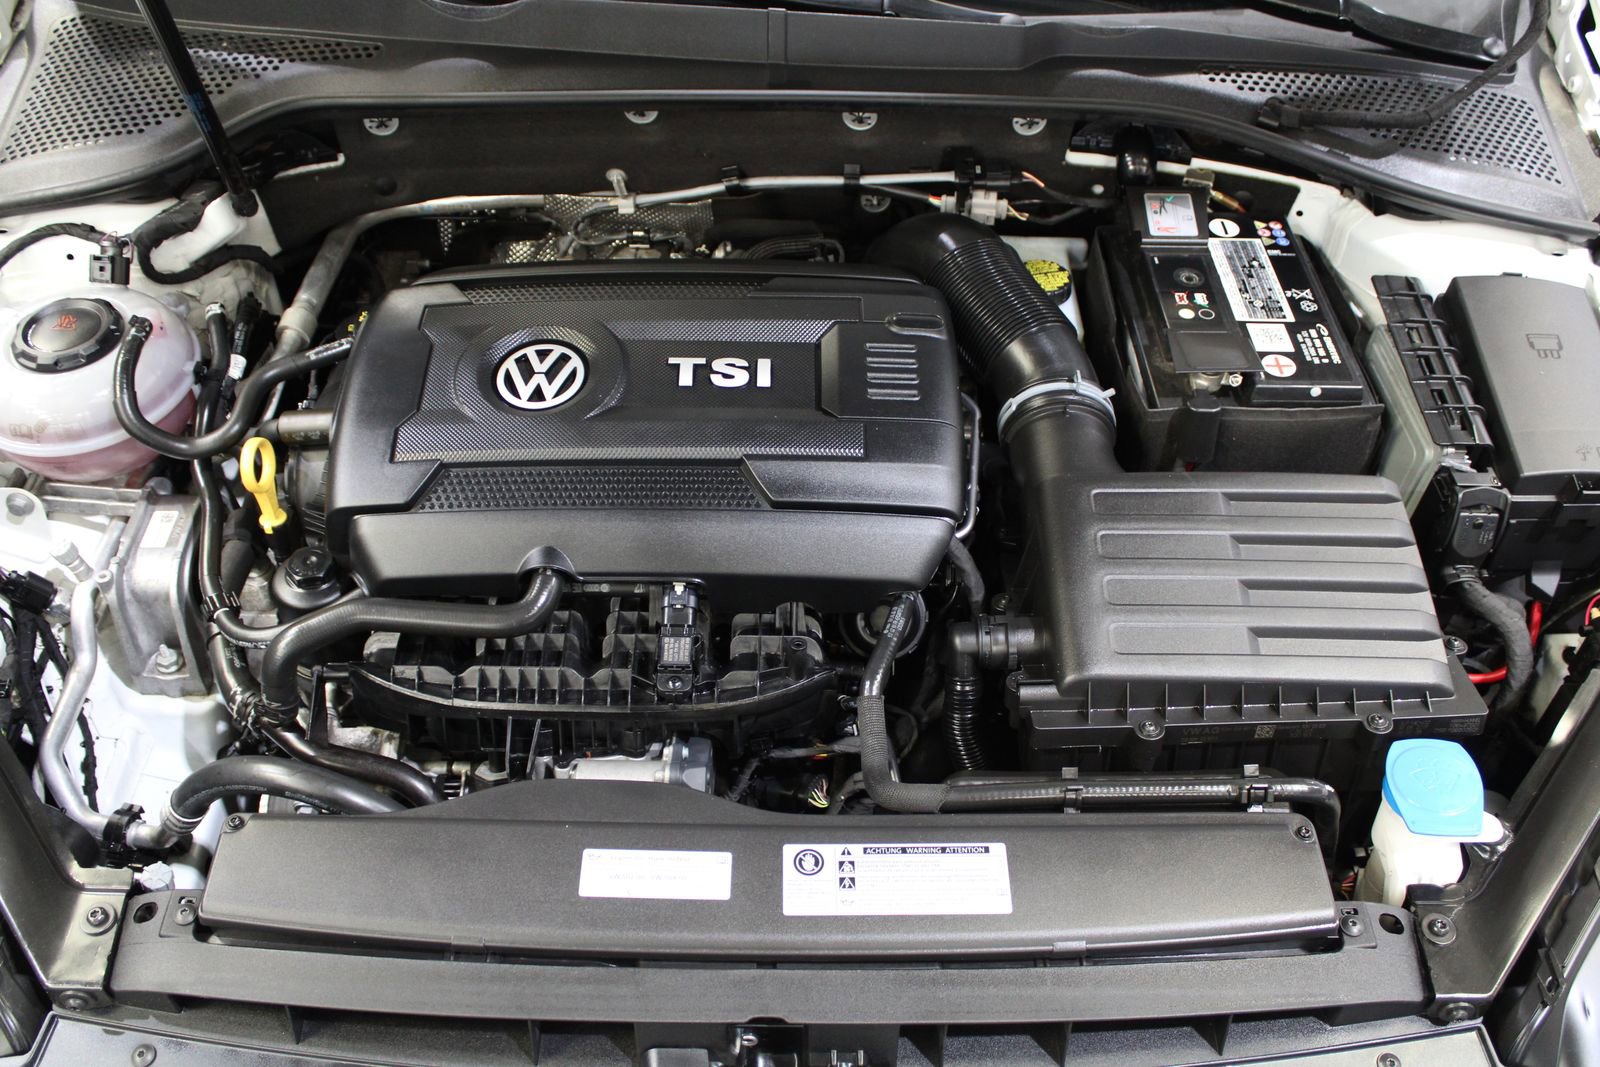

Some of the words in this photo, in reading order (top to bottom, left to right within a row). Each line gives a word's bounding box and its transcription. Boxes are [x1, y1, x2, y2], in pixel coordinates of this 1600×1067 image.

[668, 357, 772, 388] TSI
[866, 847, 902, 855] ACHTUNG
[905, 846, 942, 854] WARNING
[945, 846, 985, 854] ATTENTION
